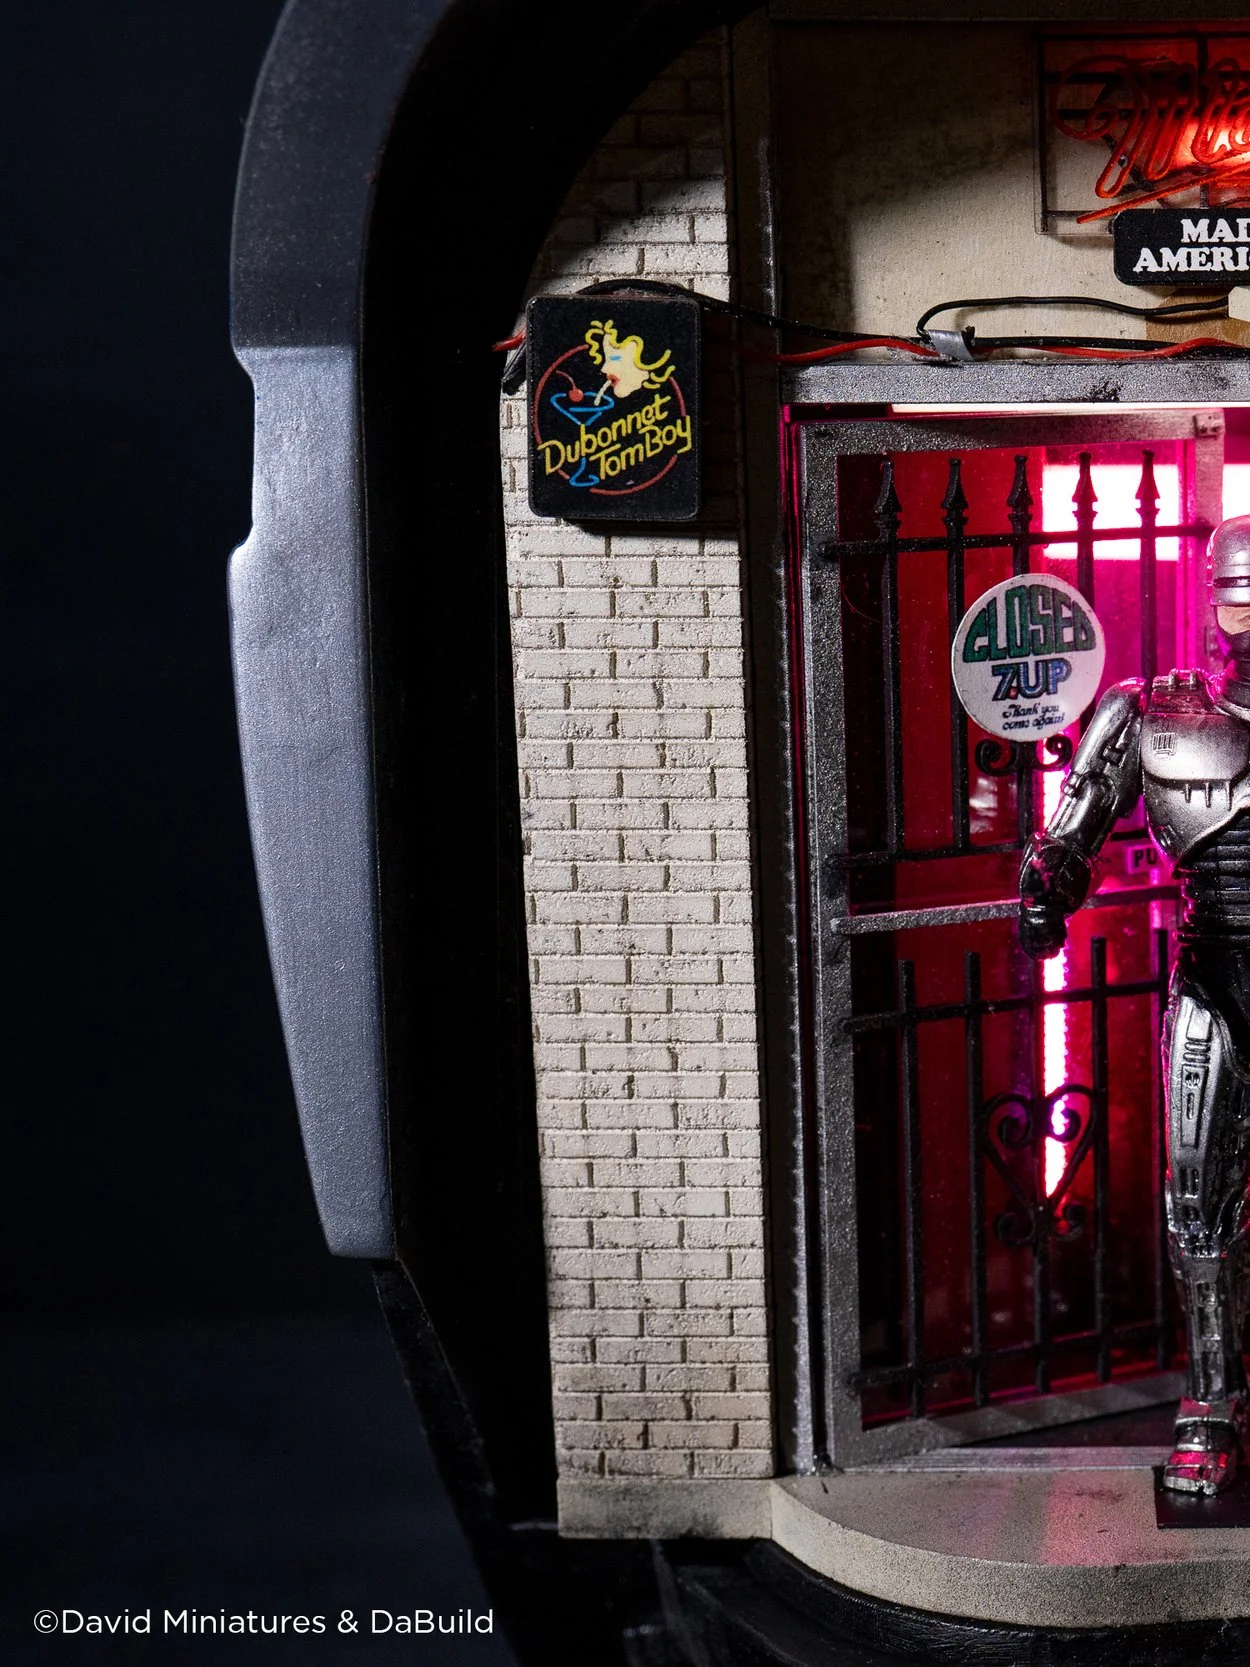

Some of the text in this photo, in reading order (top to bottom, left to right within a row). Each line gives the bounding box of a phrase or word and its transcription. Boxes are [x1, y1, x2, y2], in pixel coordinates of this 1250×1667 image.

[537, 394, 671, 476] Dubonnet
[962, 583, 1097, 663] CLOSED
[1002, 702, 1060, 719] Thank you
